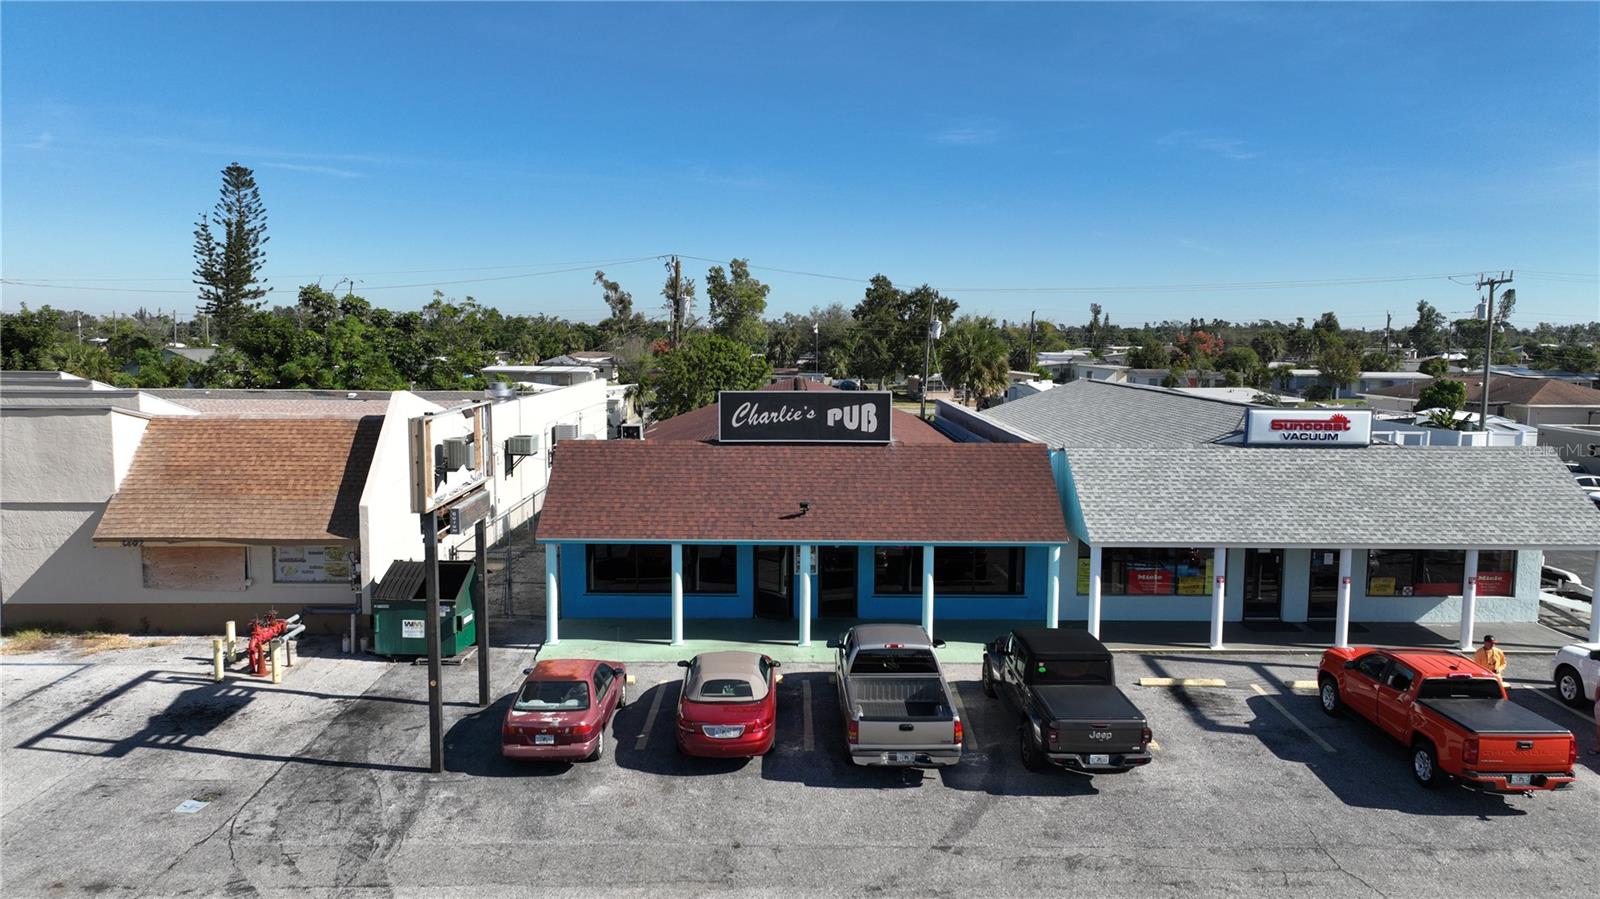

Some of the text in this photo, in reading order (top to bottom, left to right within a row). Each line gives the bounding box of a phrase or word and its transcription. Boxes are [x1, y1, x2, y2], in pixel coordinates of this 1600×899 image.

[732, 401, 878, 433] Charlie's PUB
[1271, 417, 1351, 431] Suncoast
[1282, 432, 1339, 441] VACUUM
[1088, 731, 1113, 740] Jeep
